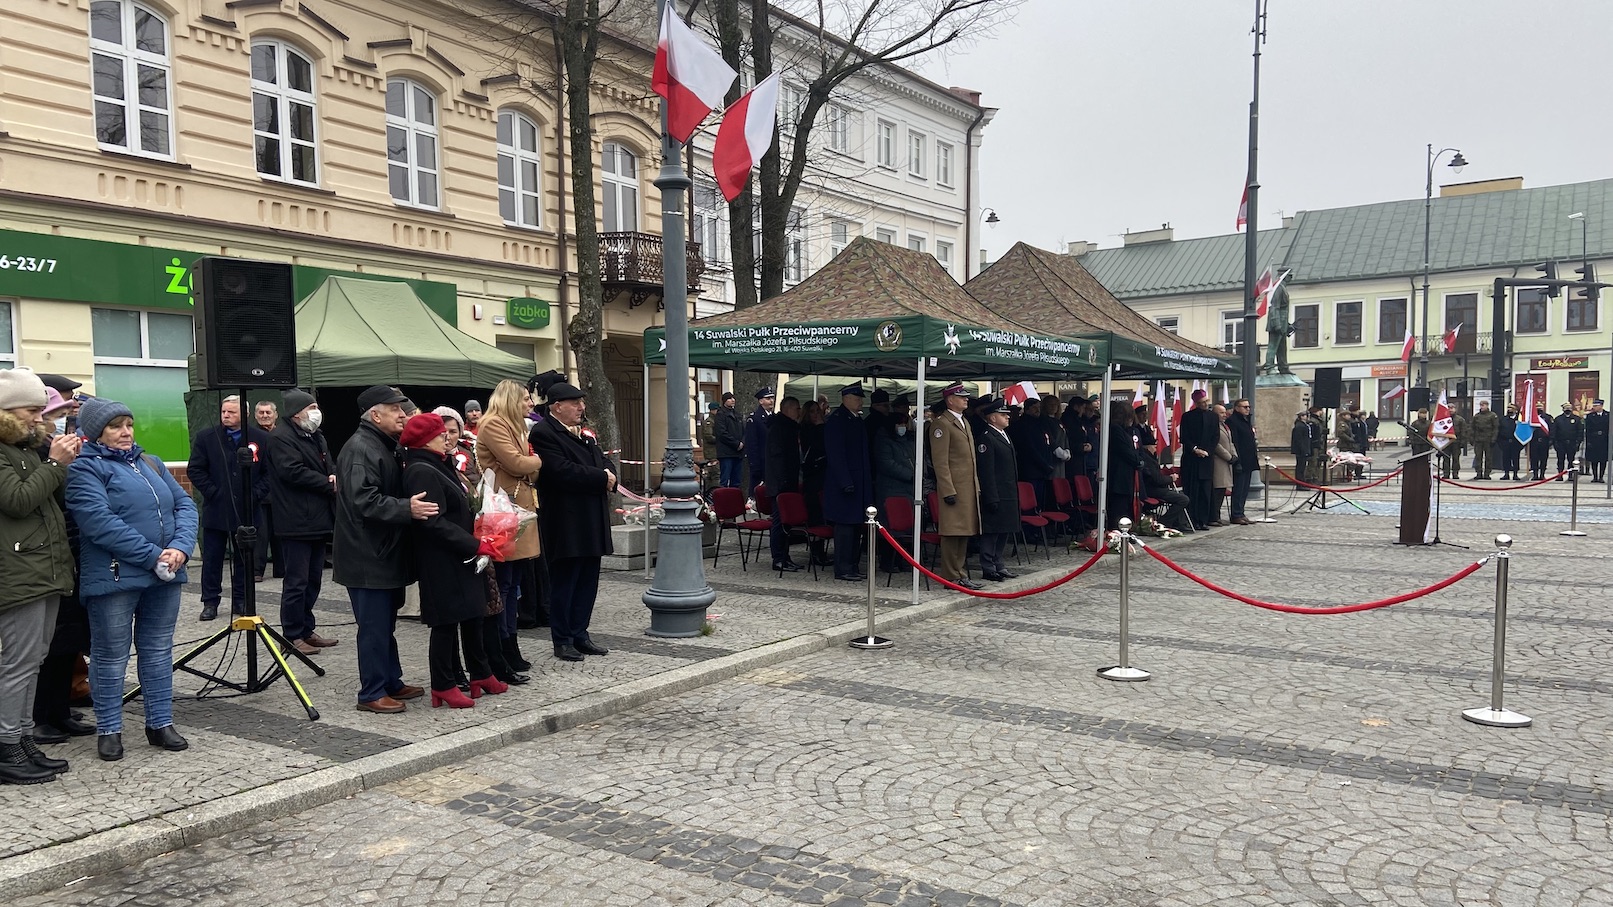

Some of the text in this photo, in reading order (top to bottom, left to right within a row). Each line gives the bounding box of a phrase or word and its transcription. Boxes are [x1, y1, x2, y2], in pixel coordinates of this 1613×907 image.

[513, 303, 548, 318] żabka
[694, 325, 859, 340] 14 Suwalski Pułk Przeciwpancerny
[712, 336, 839, 348] im. Marszałka Józefa Piłsudskiego
[981, 331, 1013, 345] Suwalski
[1030, 336, 1080, 357] Przeciwpancerny
